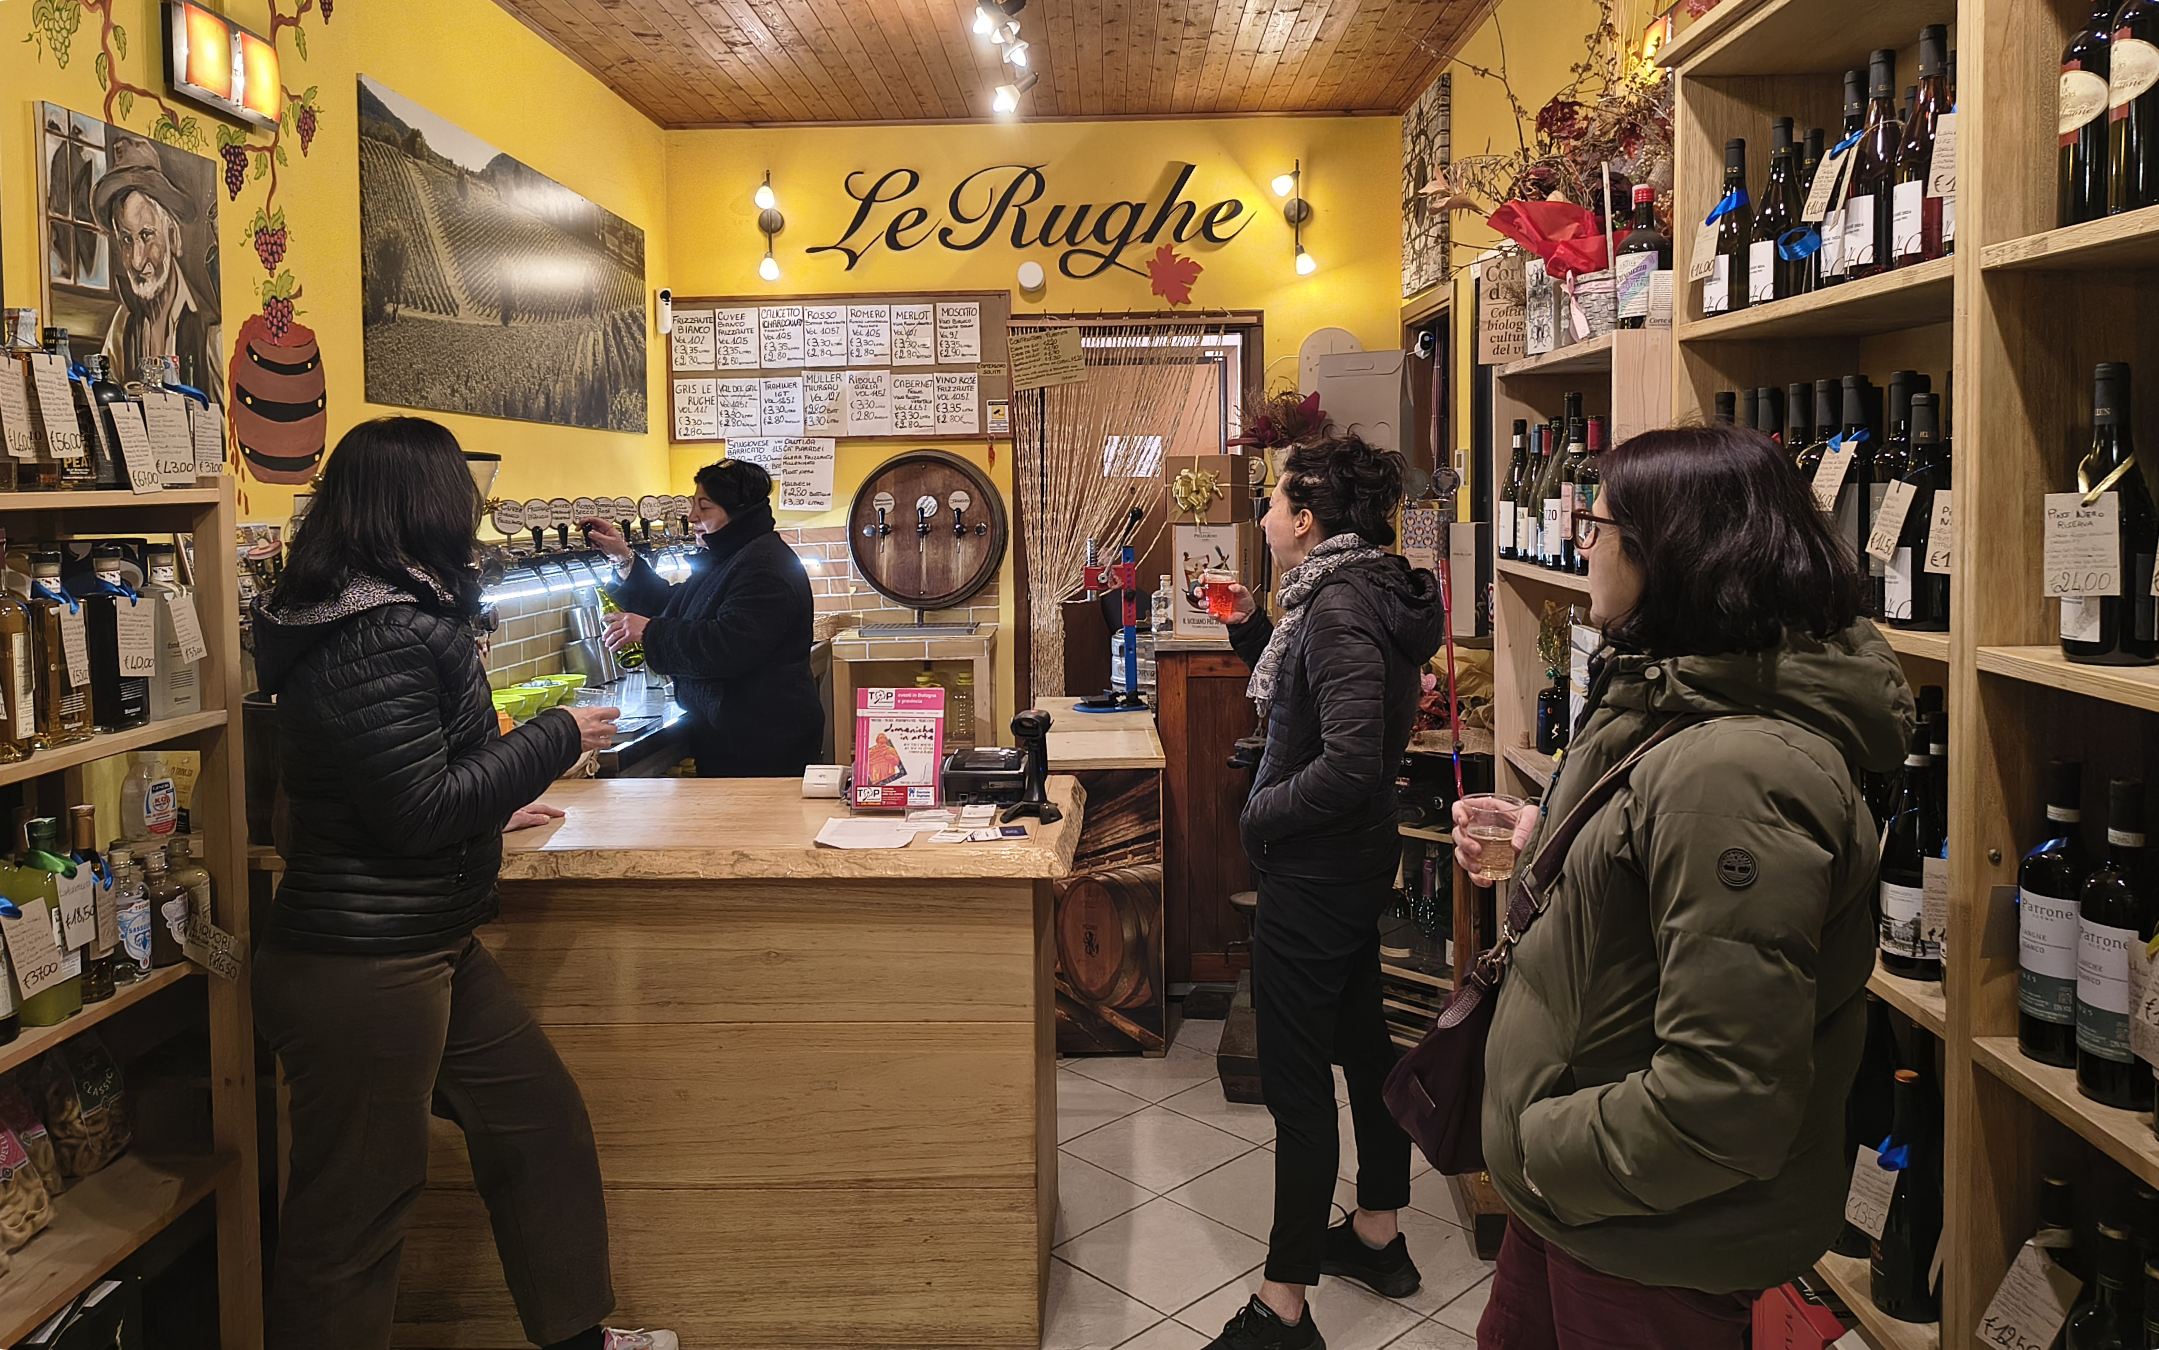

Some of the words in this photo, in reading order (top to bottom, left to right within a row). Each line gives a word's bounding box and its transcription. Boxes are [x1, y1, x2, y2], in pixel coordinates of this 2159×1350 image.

[805, 169, 941, 271] Le
[938, 163, 1257, 279] Rughe
[808, 311, 837, 319] ROSSO
[850, 309, 886, 318] ROMERO
[896, 310, 930, 320] MERLOT
[942, 308, 977, 317] MOSCATO
[673, 316, 713, 324] FRIZZANTE
[678, 326, 710, 334] BIANCO
[1492, 344, 1510, 355] del
[848, 375, 883, 384] RIBOLLA
[894, 379, 933, 388] CABERNET
[936, 376, 956, 384] VINO
[675, 385, 696, 394] GRIS
[702, 384, 711, 394] LE
[804, 383, 838, 392] THURGAU
[728, 447, 765, 456] BARRICATO
[2076, 511, 2104, 519] NERO
[2058, 521, 2094, 529] RISERVA
[884, 724, 934, 733] domeniche
[2022, 898, 2073, 920] Patrone
